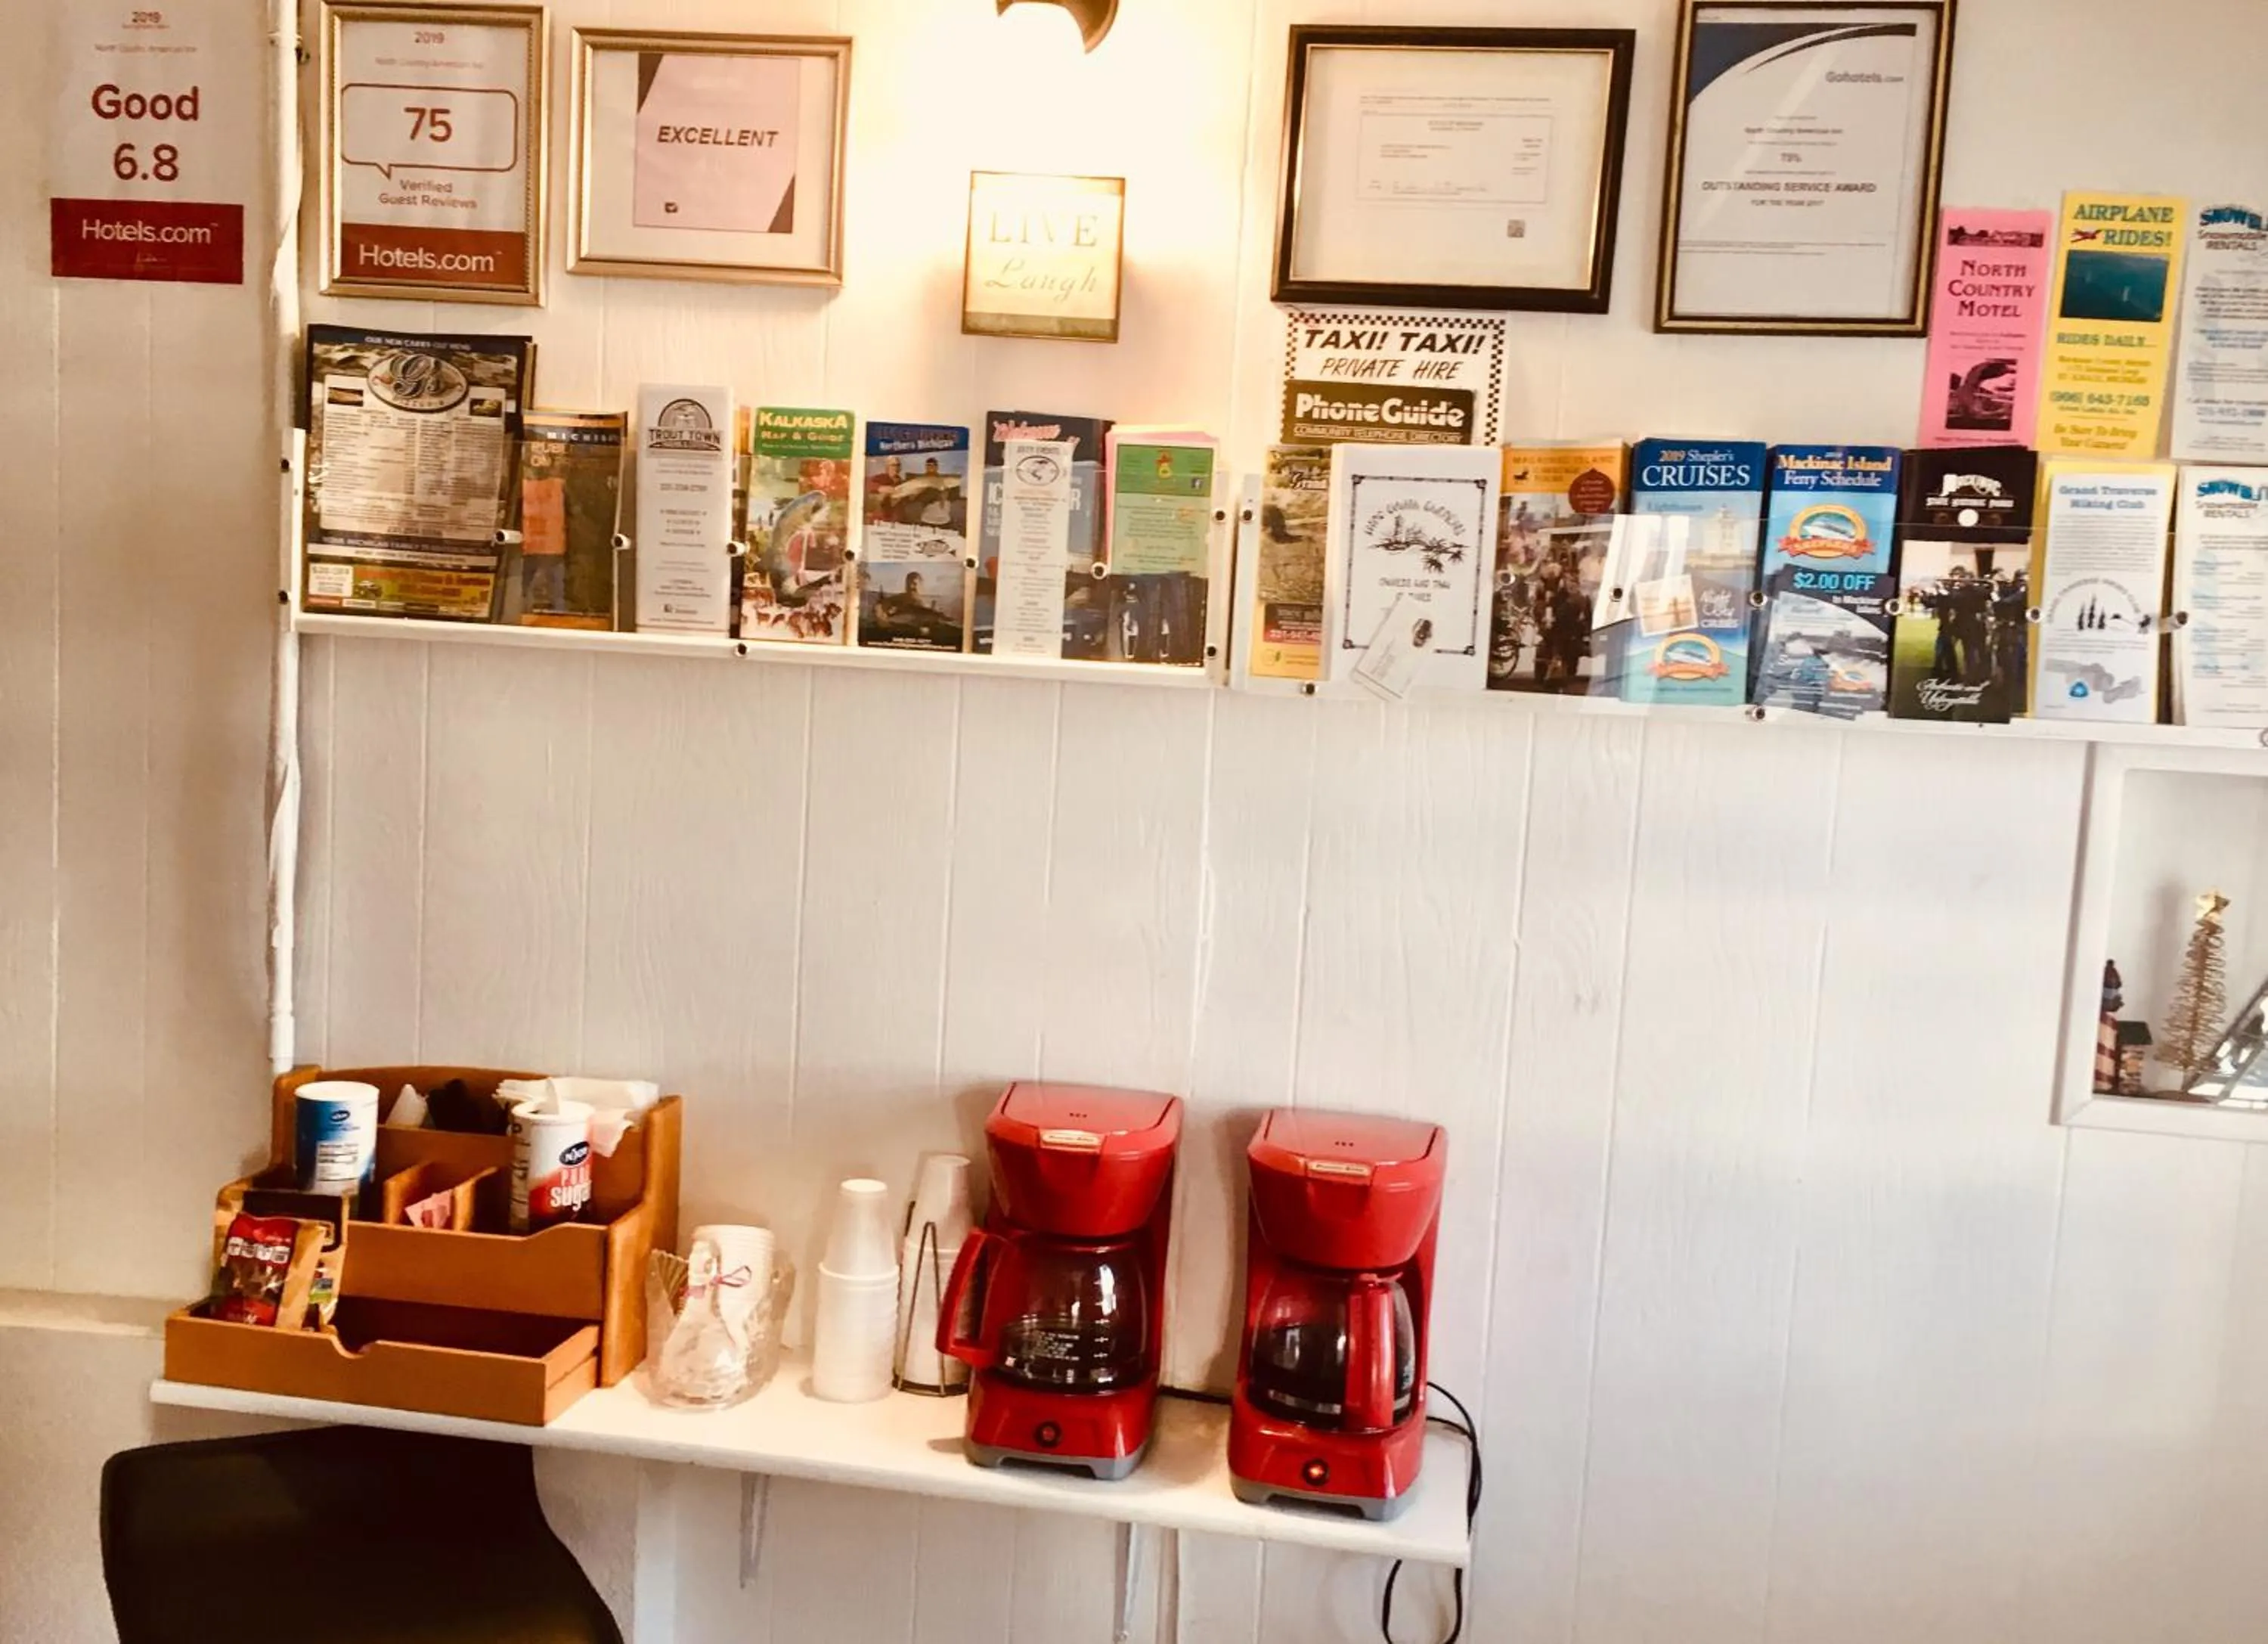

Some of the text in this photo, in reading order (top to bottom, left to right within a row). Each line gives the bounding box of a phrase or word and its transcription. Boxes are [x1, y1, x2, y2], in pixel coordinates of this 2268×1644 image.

[414, 32, 445, 44] 2019
[91, 84, 199, 121] Good
[404, 107, 452, 142] 75
[657, 125, 779, 147] EXCELLENT
[113, 143, 179, 181] 6.8
[399, 179, 454, 194] Verified
[1701, 181, 1878, 193] OUTSTANDING SERVICE AWARD
[379, 193, 478, 209] Guest Reviews
[2073, 203, 2174, 223] AIRPLANE
[82, 219, 212, 244] Hotels.com
[989, 210, 1099, 247] LIVE
[2102, 229, 2173, 247] RIDES!
[359, 243, 495, 272] Hotels.com
[1960, 259, 2027, 278] NORTH
[984, 256, 1098, 303] Laugh
[1947, 280, 2035, 298] COUNTRY
[1957, 301, 2022, 318] MOTEL
[1304, 329, 1486, 355] TAXI! TAXI!
[1320, 358, 1464, 380] PRIVATE HIRE
[1295, 392, 1466, 428] PhoneGuide
[759, 411, 847, 429] KALKASKA
[648, 429, 721, 444] TROUT TOWN
[792, 431, 802, 441] &
[1777, 454, 1893, 471] Mackinac Island
[1641, 464, 1752, 487] CRUISES
[1783, 470, 1882, 489] Ferry Schedule
[2059, 484, 2158, 497] Grand Traverse
[2116, 499, 2146, 510] Club
[1792, 571, 1876, 591] $2.00 OFF
